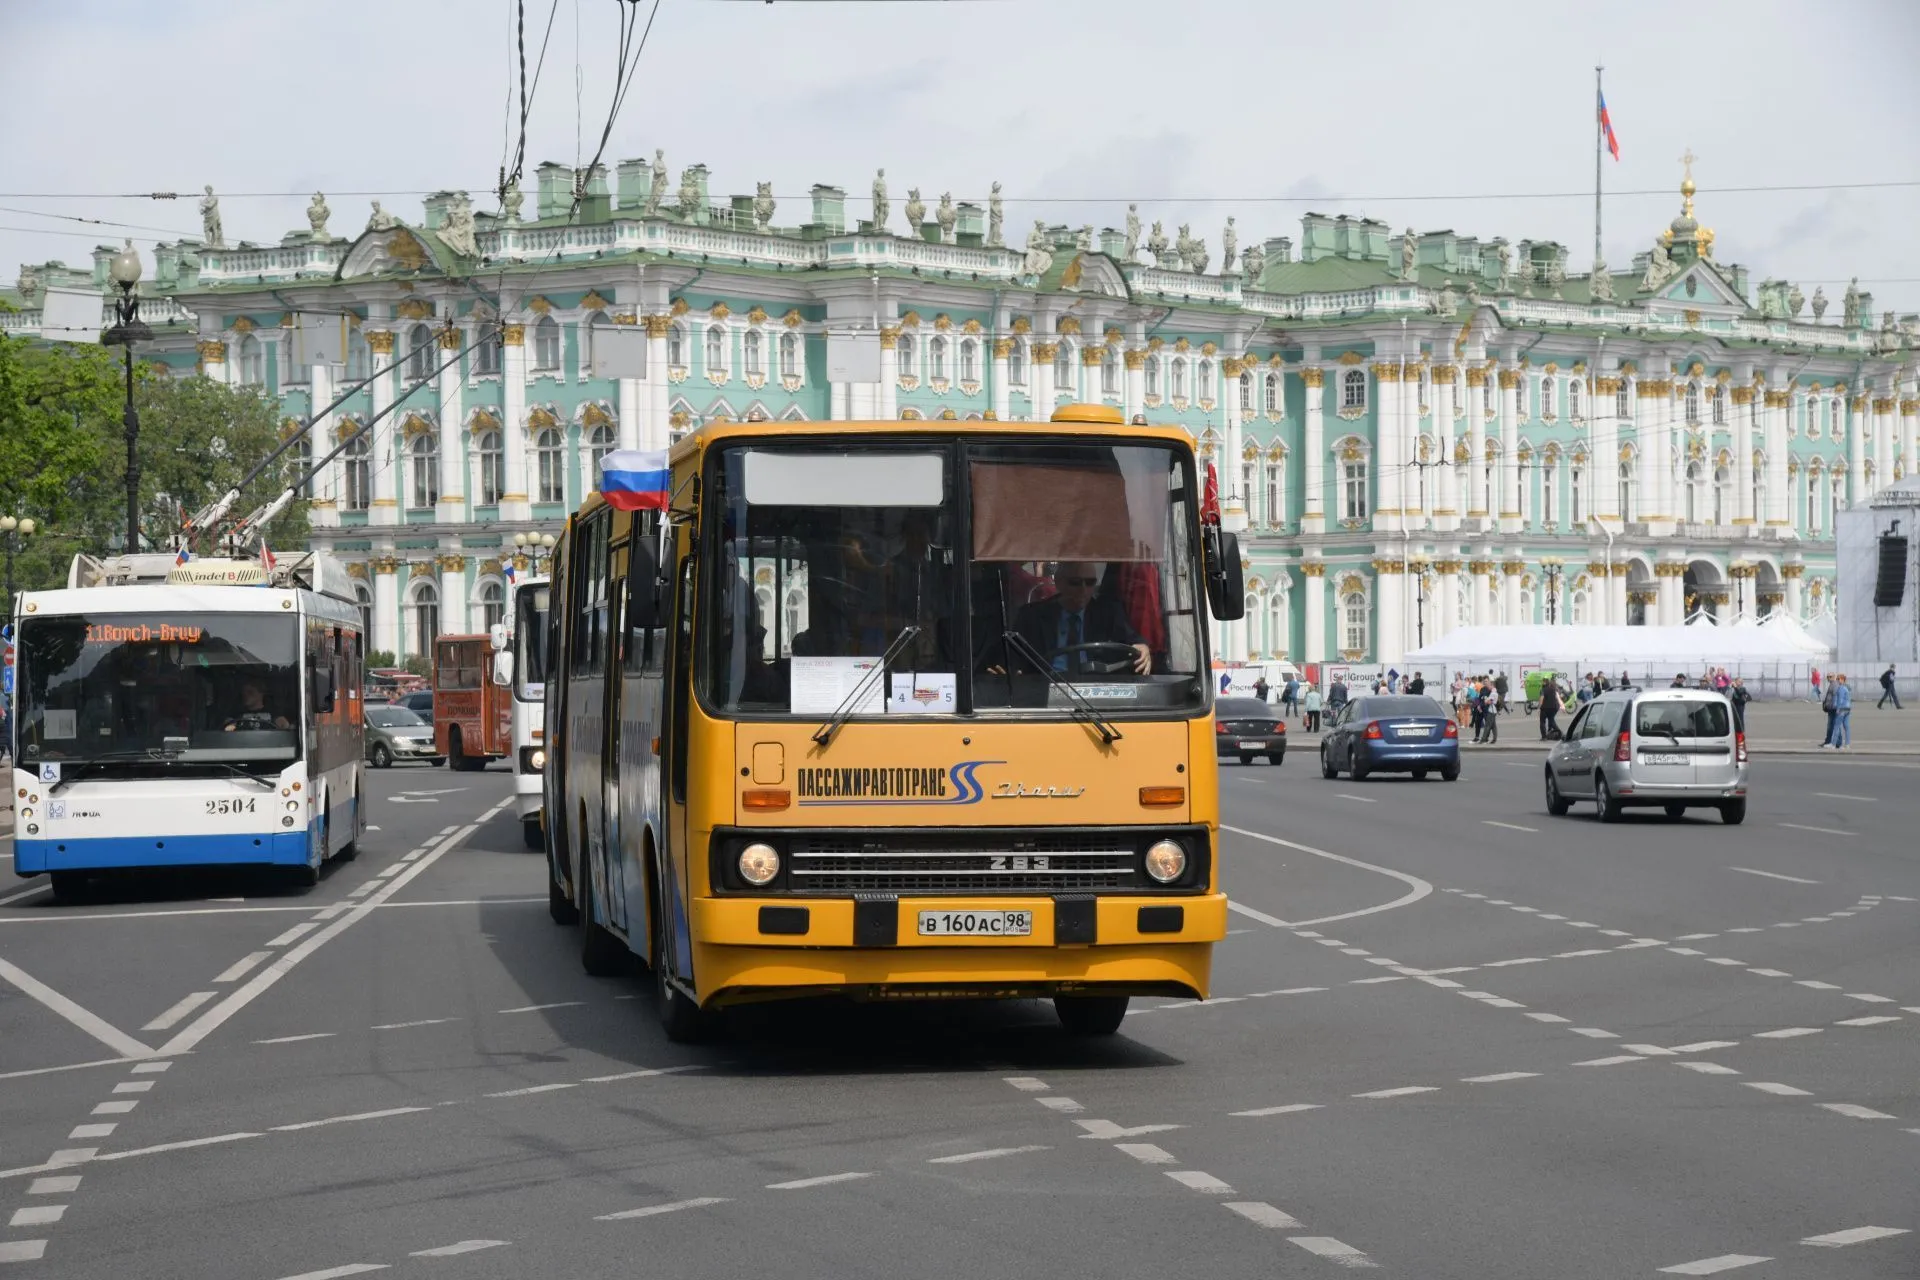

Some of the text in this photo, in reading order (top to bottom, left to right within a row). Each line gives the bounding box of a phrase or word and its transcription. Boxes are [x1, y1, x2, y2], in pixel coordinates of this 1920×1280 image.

[194, 571, 225, 581] indel
[898, 692, 906, 703] 4
[945, 692, 953, 703] 5
[798, 767, 946, 797] ПАССАЖИРАВТОТРАНС
[205, 797, 257, 815] 2504
